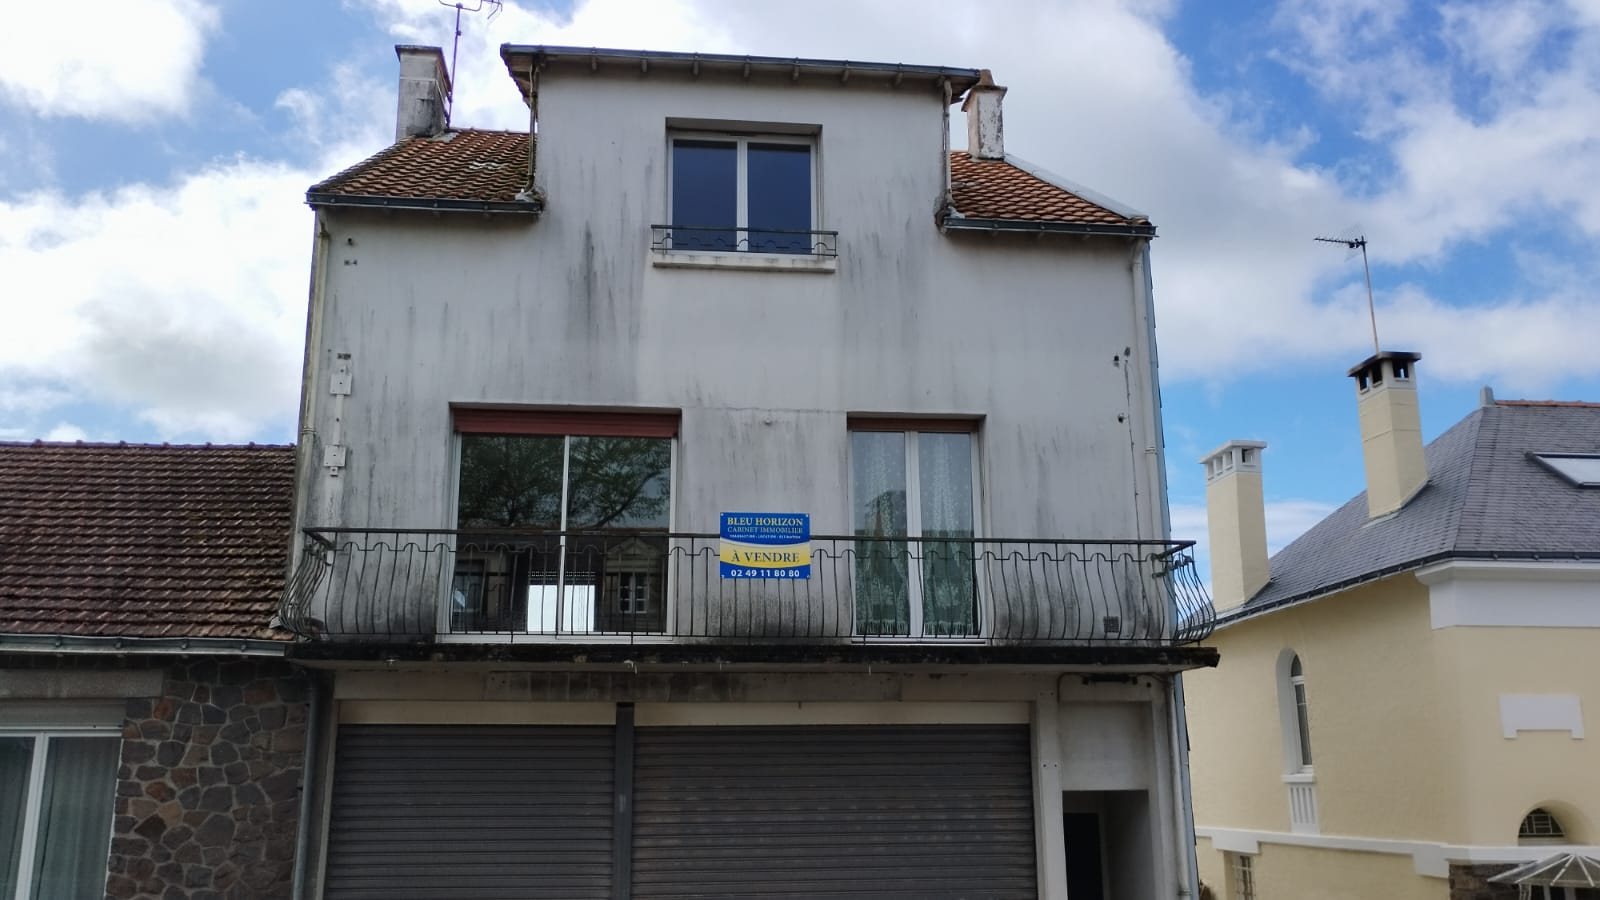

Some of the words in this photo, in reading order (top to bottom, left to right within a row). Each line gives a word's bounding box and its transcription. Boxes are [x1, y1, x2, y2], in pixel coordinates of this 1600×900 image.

[728, 517, 752, 526] BLEU
[755, 517, 803, 526] HORIZON
[731, 549, 740, 562] À
[744, 551, 800, 563] VENDRE
[730, 569, 743, 577] 02
[745, 569, 757, 577] 49
[760, 569, 771, 577] 11
[774, 569, 786, 577] 80
[788, 569, 800, 577] 80
